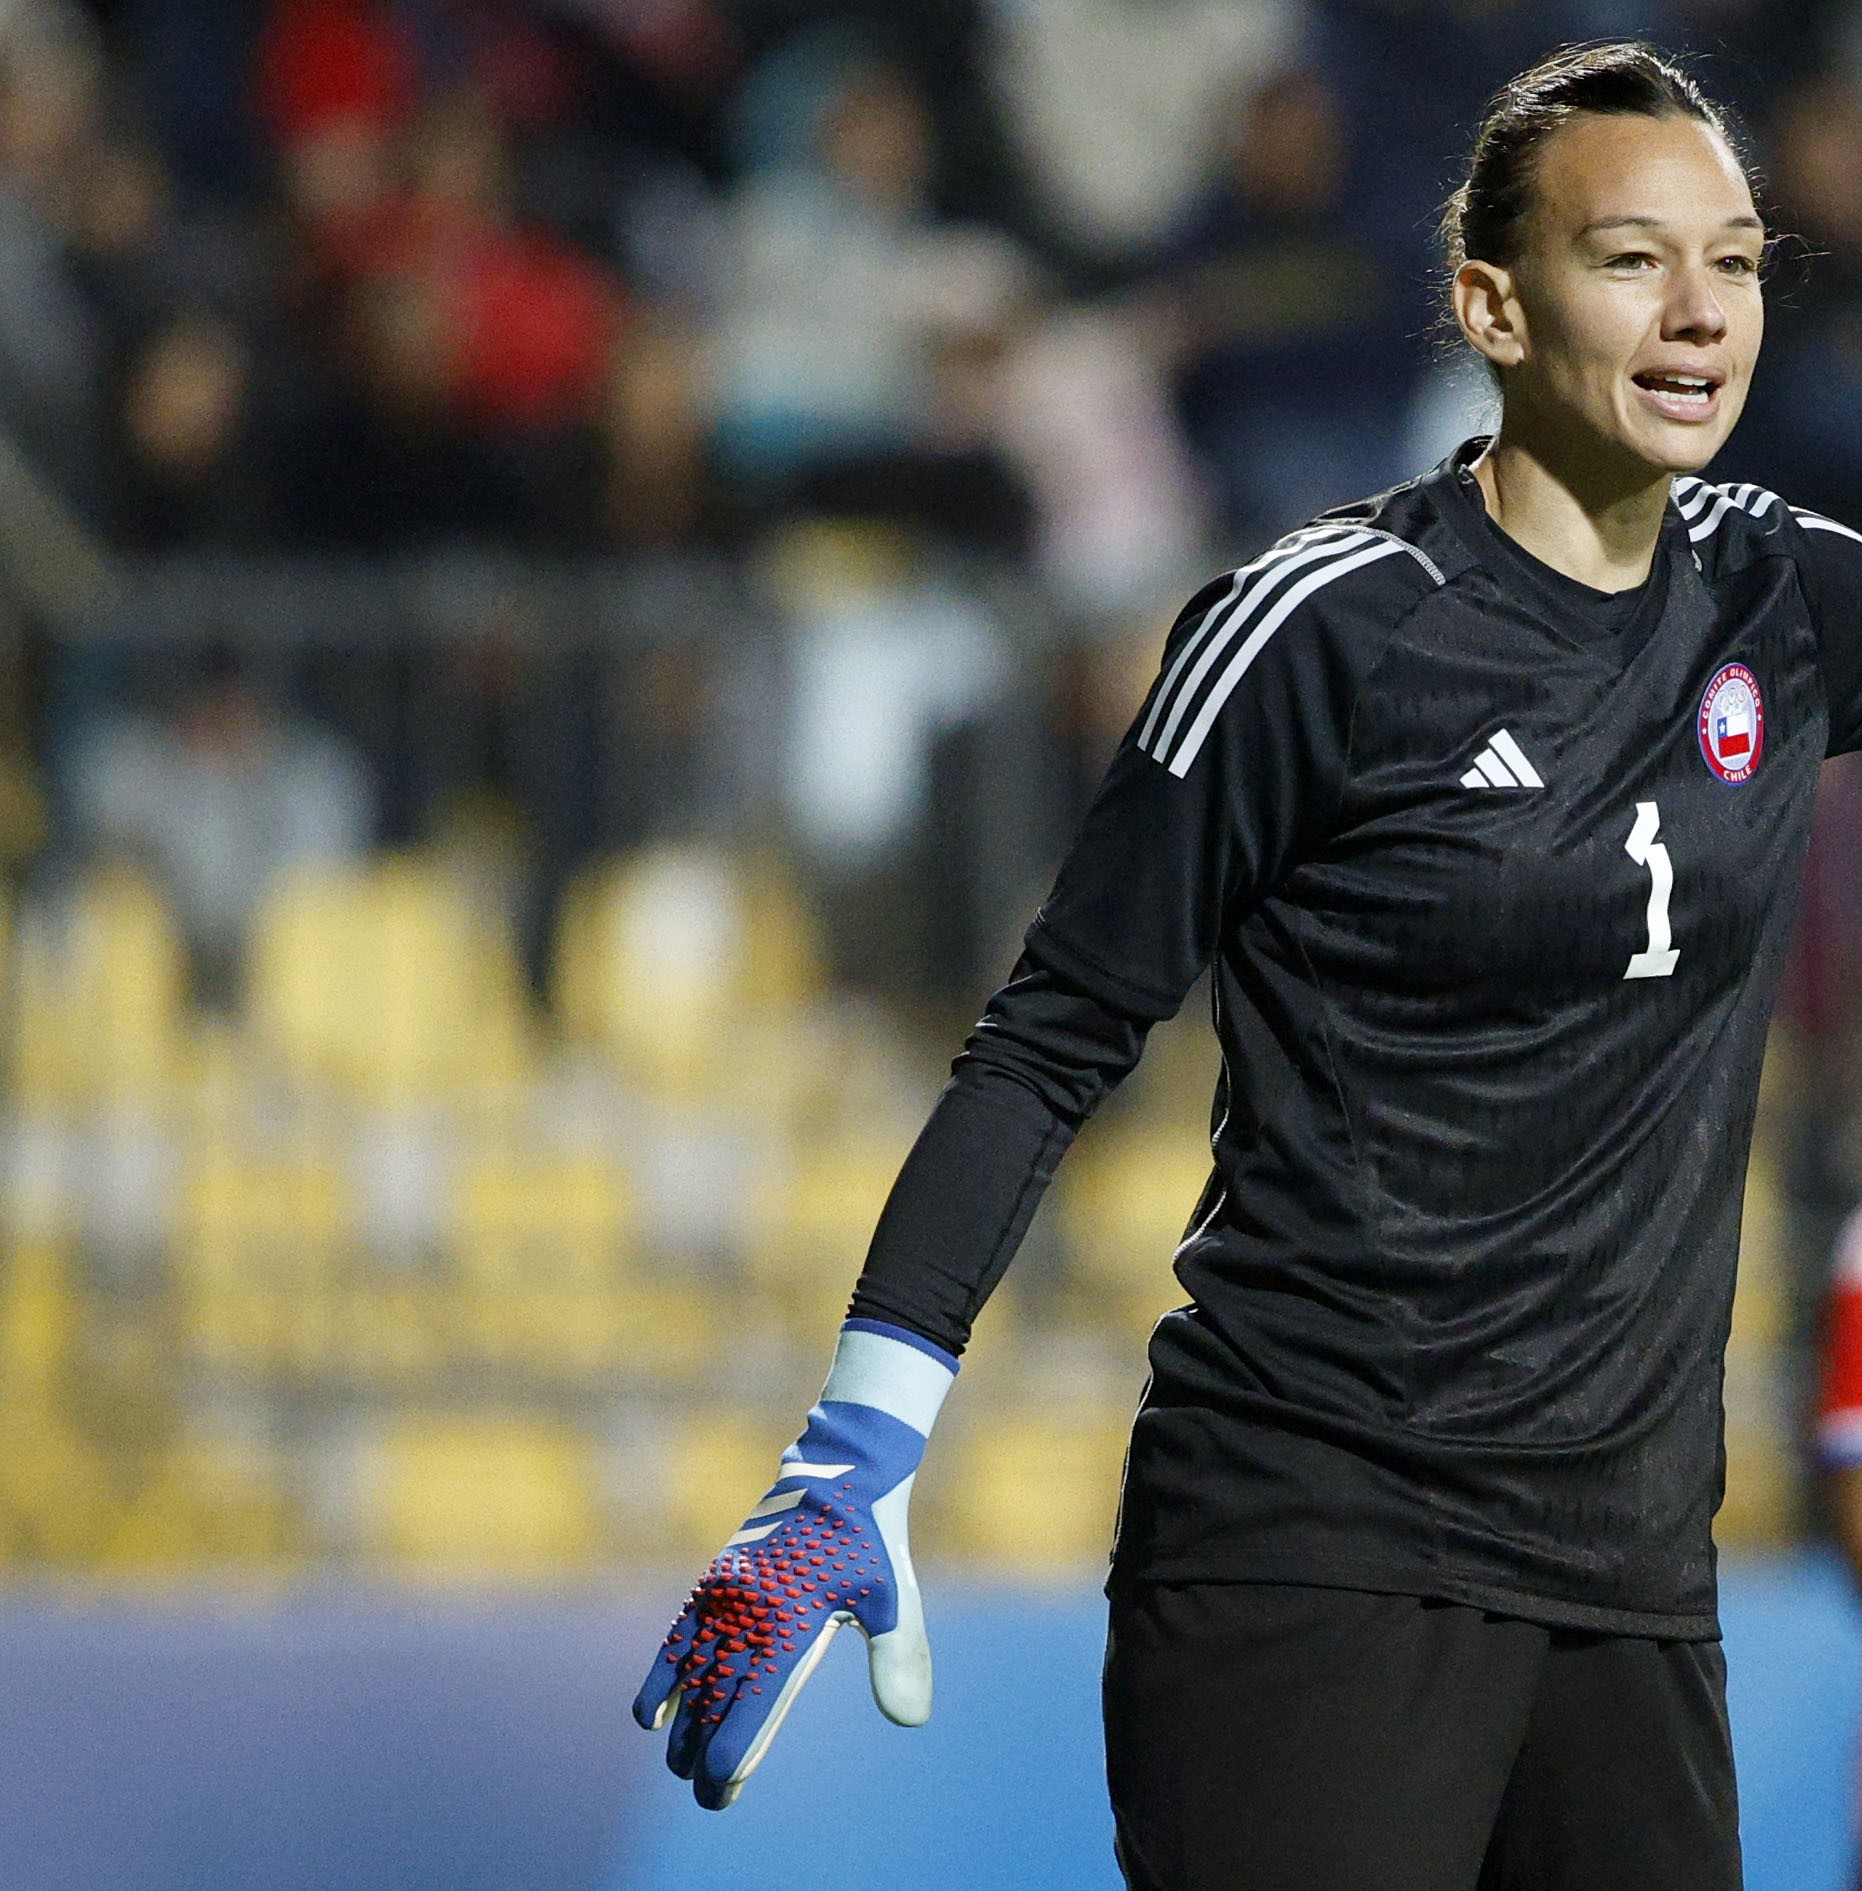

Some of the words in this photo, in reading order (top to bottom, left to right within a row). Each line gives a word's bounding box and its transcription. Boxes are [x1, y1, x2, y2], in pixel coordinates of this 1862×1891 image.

[1702, 673, 1727, 719] COMITE
[1729, 667, 1761, 708] OLIMPICO
[1723, 764, 1752, 782] CHILE
[1622, 801, 1681, 980] 1
